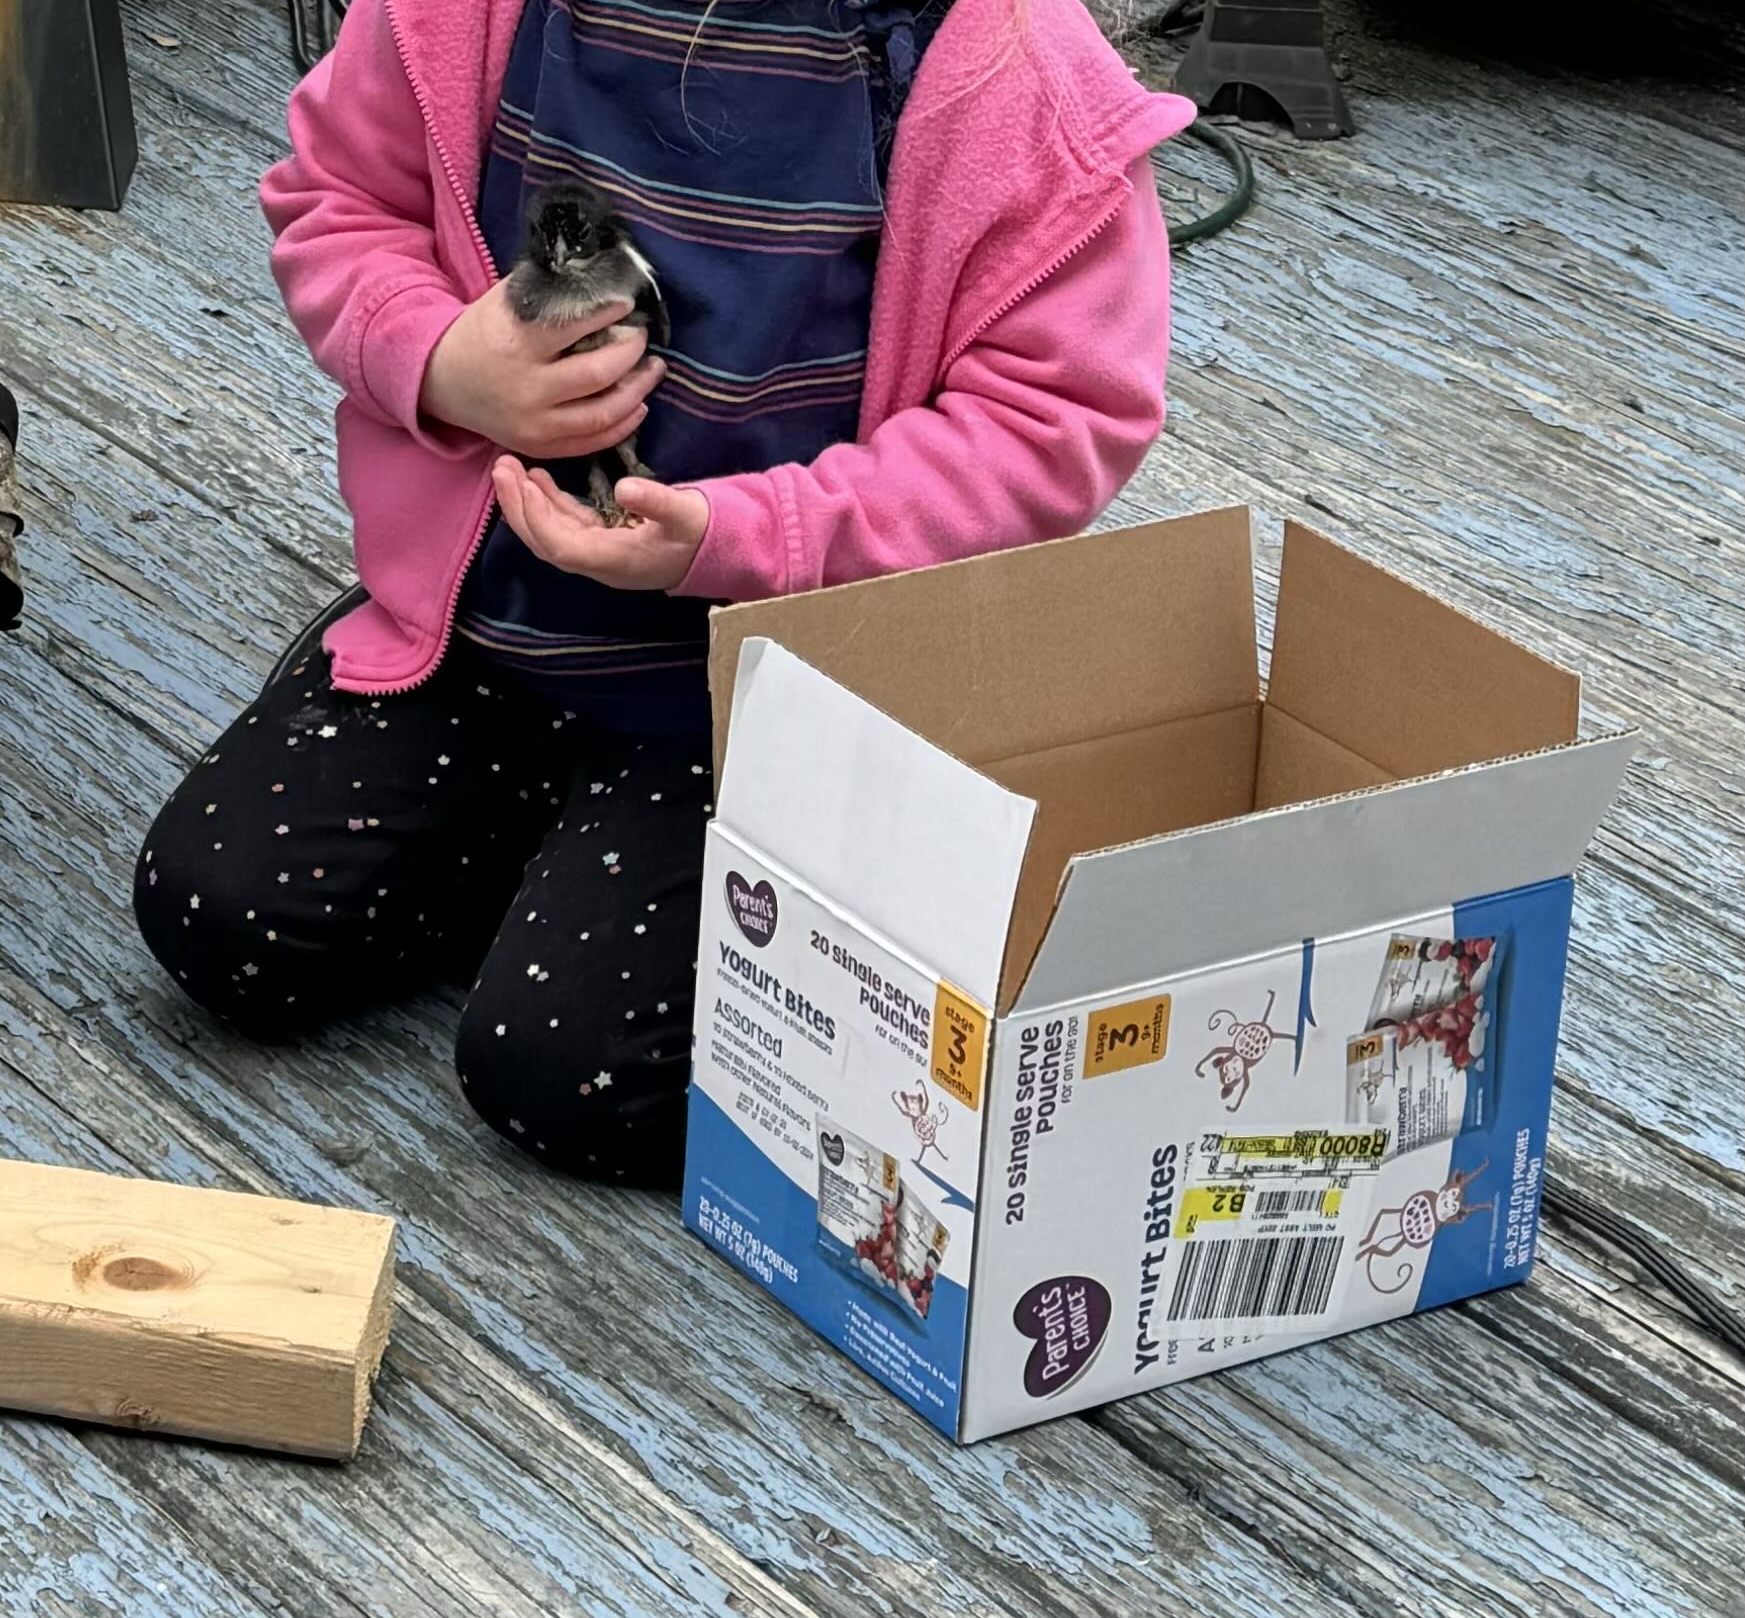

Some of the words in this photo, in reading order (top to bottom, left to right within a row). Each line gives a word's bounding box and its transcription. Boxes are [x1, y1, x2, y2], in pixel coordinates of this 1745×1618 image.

[732, 883, 774, 920] Parent's
[719, 940, 782, 1002] Yogurt
[785, 988, 837, 1041] Bites
[810, 929, 830, 956] 20
[884, 982, 930, 1028] serve
[714, 998, 783, 1060] Assorted
[945, 1006, 975, 1034] stage
[949, 1024, 967, 1066] 3
[1095, 1023, 1108, 1063] stage
[1109, 1024, 1139, 1051] 3
[1151, 1004, 1164, 1054] months
[1065, 1039, 1076, 1062] the
[1359, 1041, 1377, 1057] 3
[1006, 1192, 1025, 1225] 20
[1016, 1026, 1039, 1102] serve
[1511, 1127, 1530, 1180] POUCHES
[1144, 1144, 1178, 1244] Bites
[762, 1242, 798, 1285] POUCHES
[1032, 1286, 1070, 1380] Parent's
[1067, 1286, 1090, 1351] CHOICE
